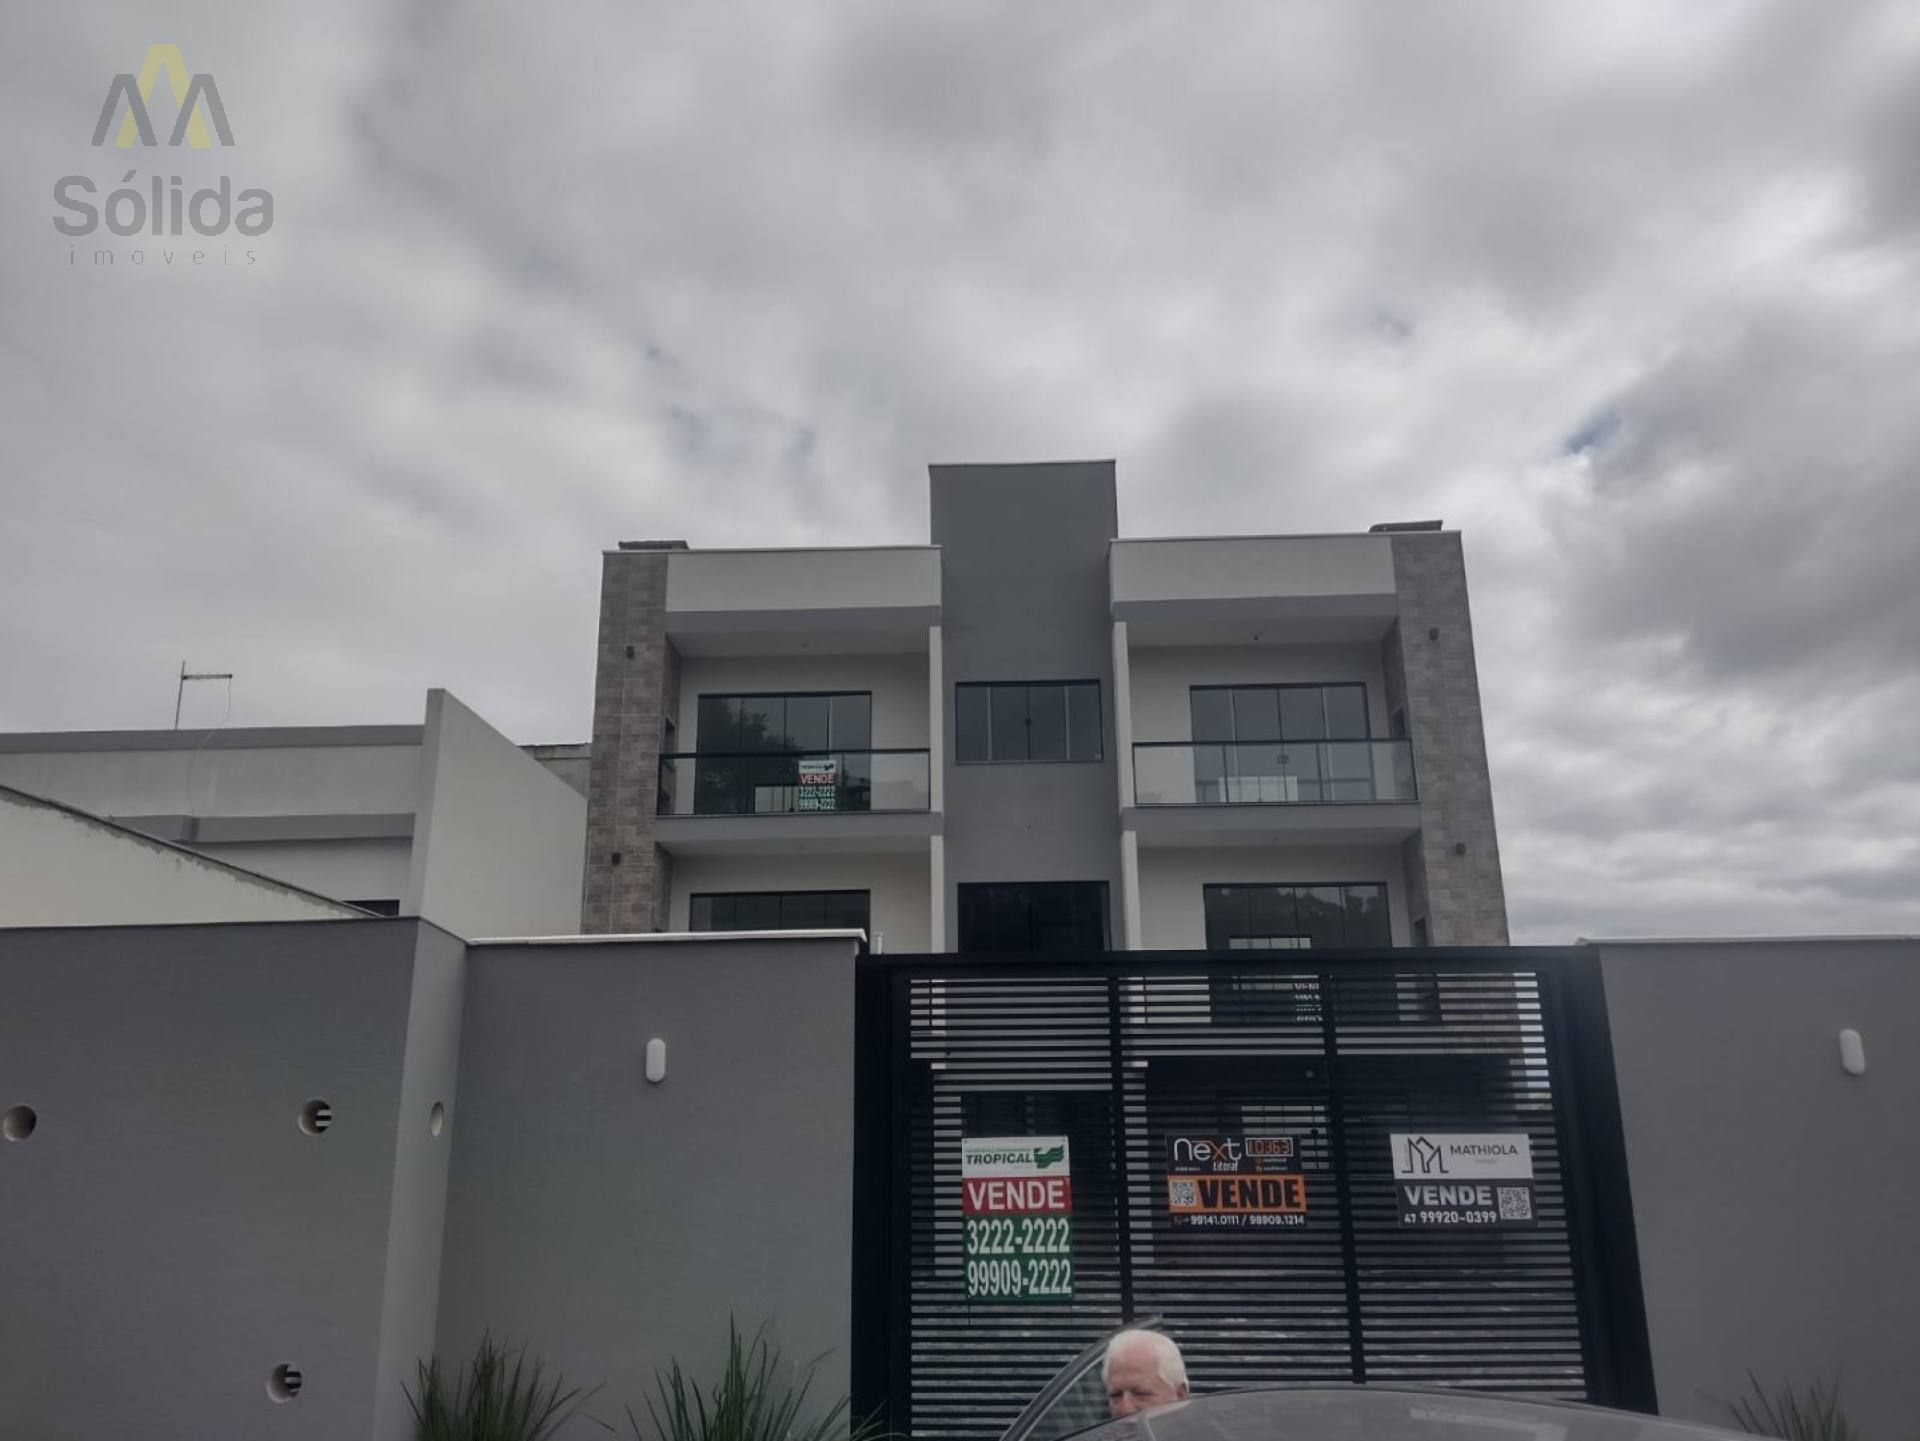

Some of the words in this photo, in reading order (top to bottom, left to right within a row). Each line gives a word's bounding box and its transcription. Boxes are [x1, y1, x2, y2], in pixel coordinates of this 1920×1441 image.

[801, 774, 834, 784] VENDE
[965, 1153, 1034, 1165] TROPICAL
[1449, 1144, 1519, 1156] MATHIOLA
[967, 1180, 1066, 1210] VENDE
[1198, 1179, 1302, 1208] VENDE
[1404, 1185, 1494, 1206] VENDE
[1404, 1212, 1417, 1224] 47
[1420, 1210, 1498, 1223] 99920-0399
[966, 1217, 1071, 1255] 3222-2222
[967, 1258, 1073, 1296] 99909-2222
